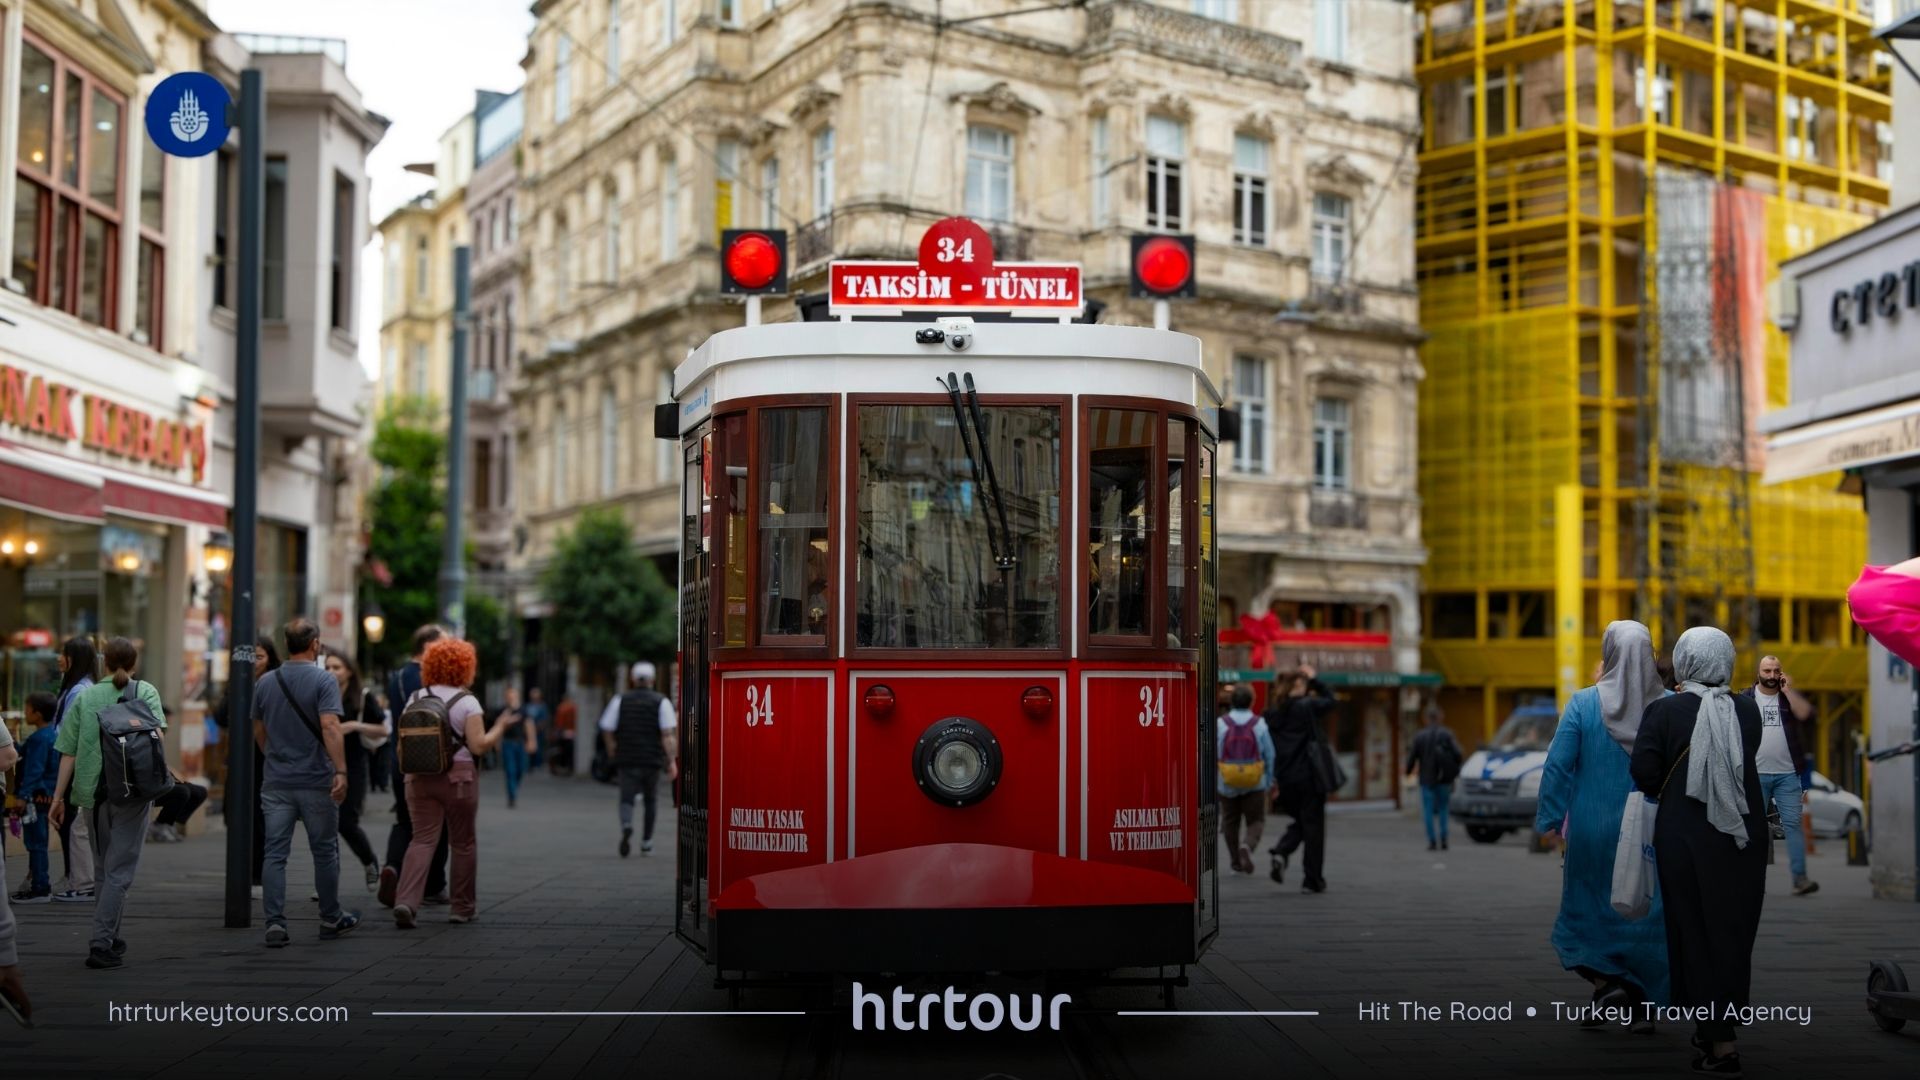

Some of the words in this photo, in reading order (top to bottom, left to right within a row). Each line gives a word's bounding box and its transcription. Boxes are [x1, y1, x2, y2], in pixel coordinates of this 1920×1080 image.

[936, 237, 975, 263] 34
[843, 270, 952, 299] TAKSİM
[982, 271, 1073, 300] TÜNEL
[746, 684, 774, 727] 34
[1138, 685, 1165, 727] 34
[730, 807, 765, 828] ASILMAK
[767, 809, 804, 829] YASAK
[1113, 807, 1159, 828] ASILMAK
[1160, 807, 1180, 826] YASAK
[728, 830, 736, 849] VE
[1110, 831, 1125, 851] VE
